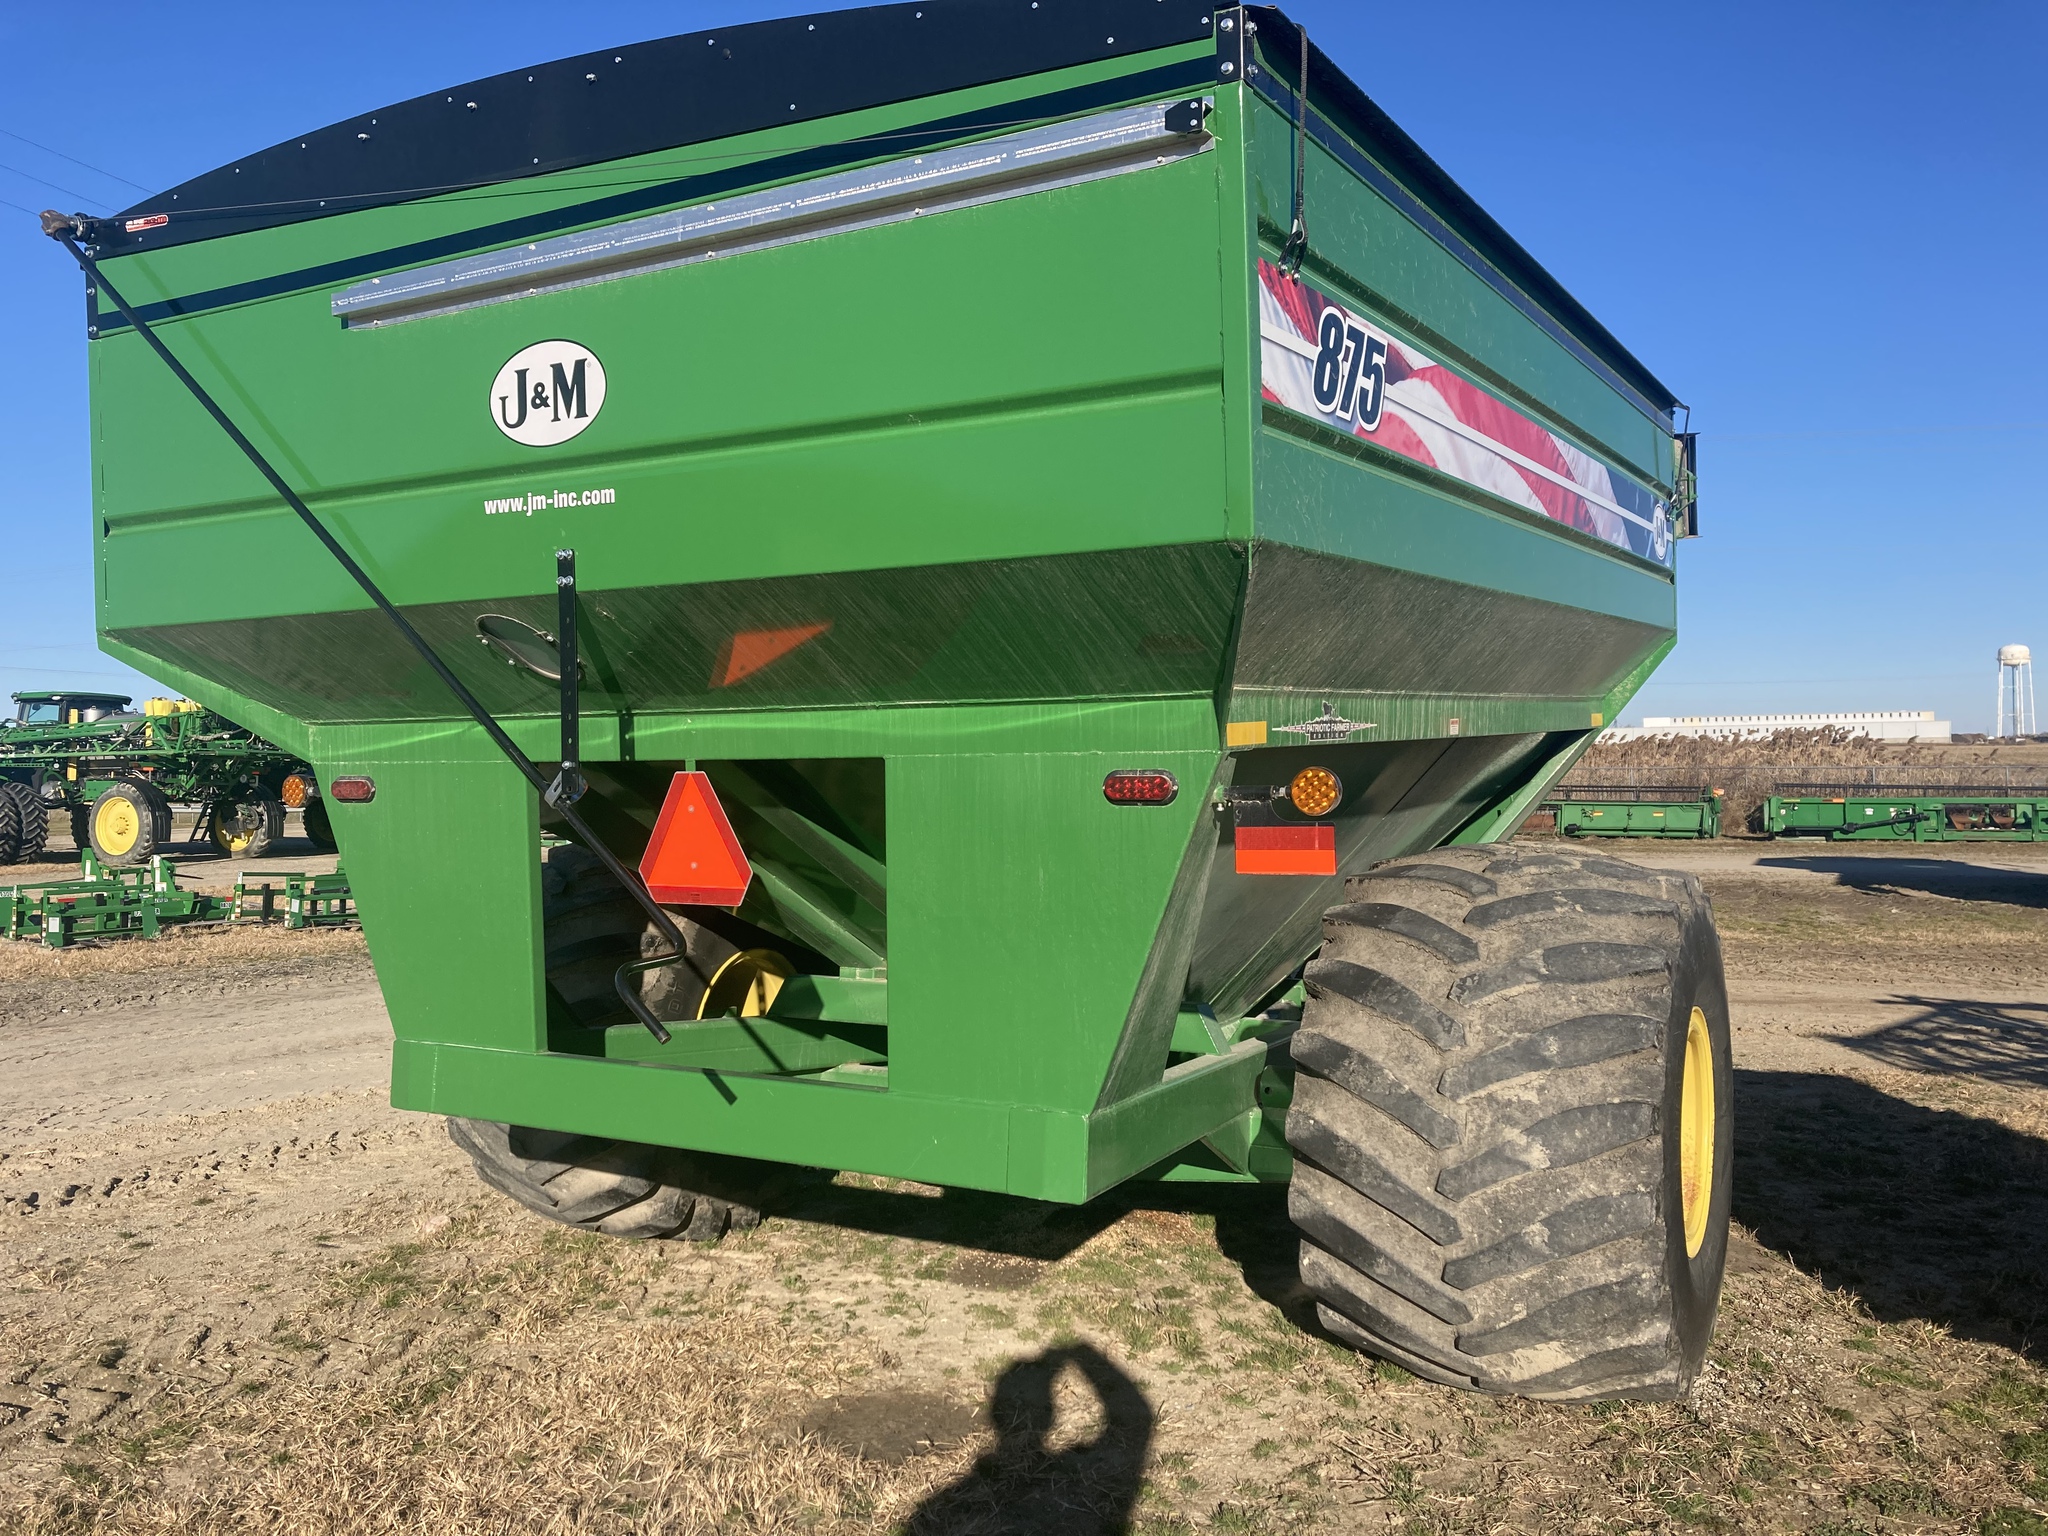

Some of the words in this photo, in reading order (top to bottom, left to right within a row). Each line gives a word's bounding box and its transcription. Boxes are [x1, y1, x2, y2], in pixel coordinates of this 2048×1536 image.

[499, 358, 589, 429] J&M
[1313, 307, 1387, 430] 875
[484, 488, 616, 516] www.jm-inc.com
